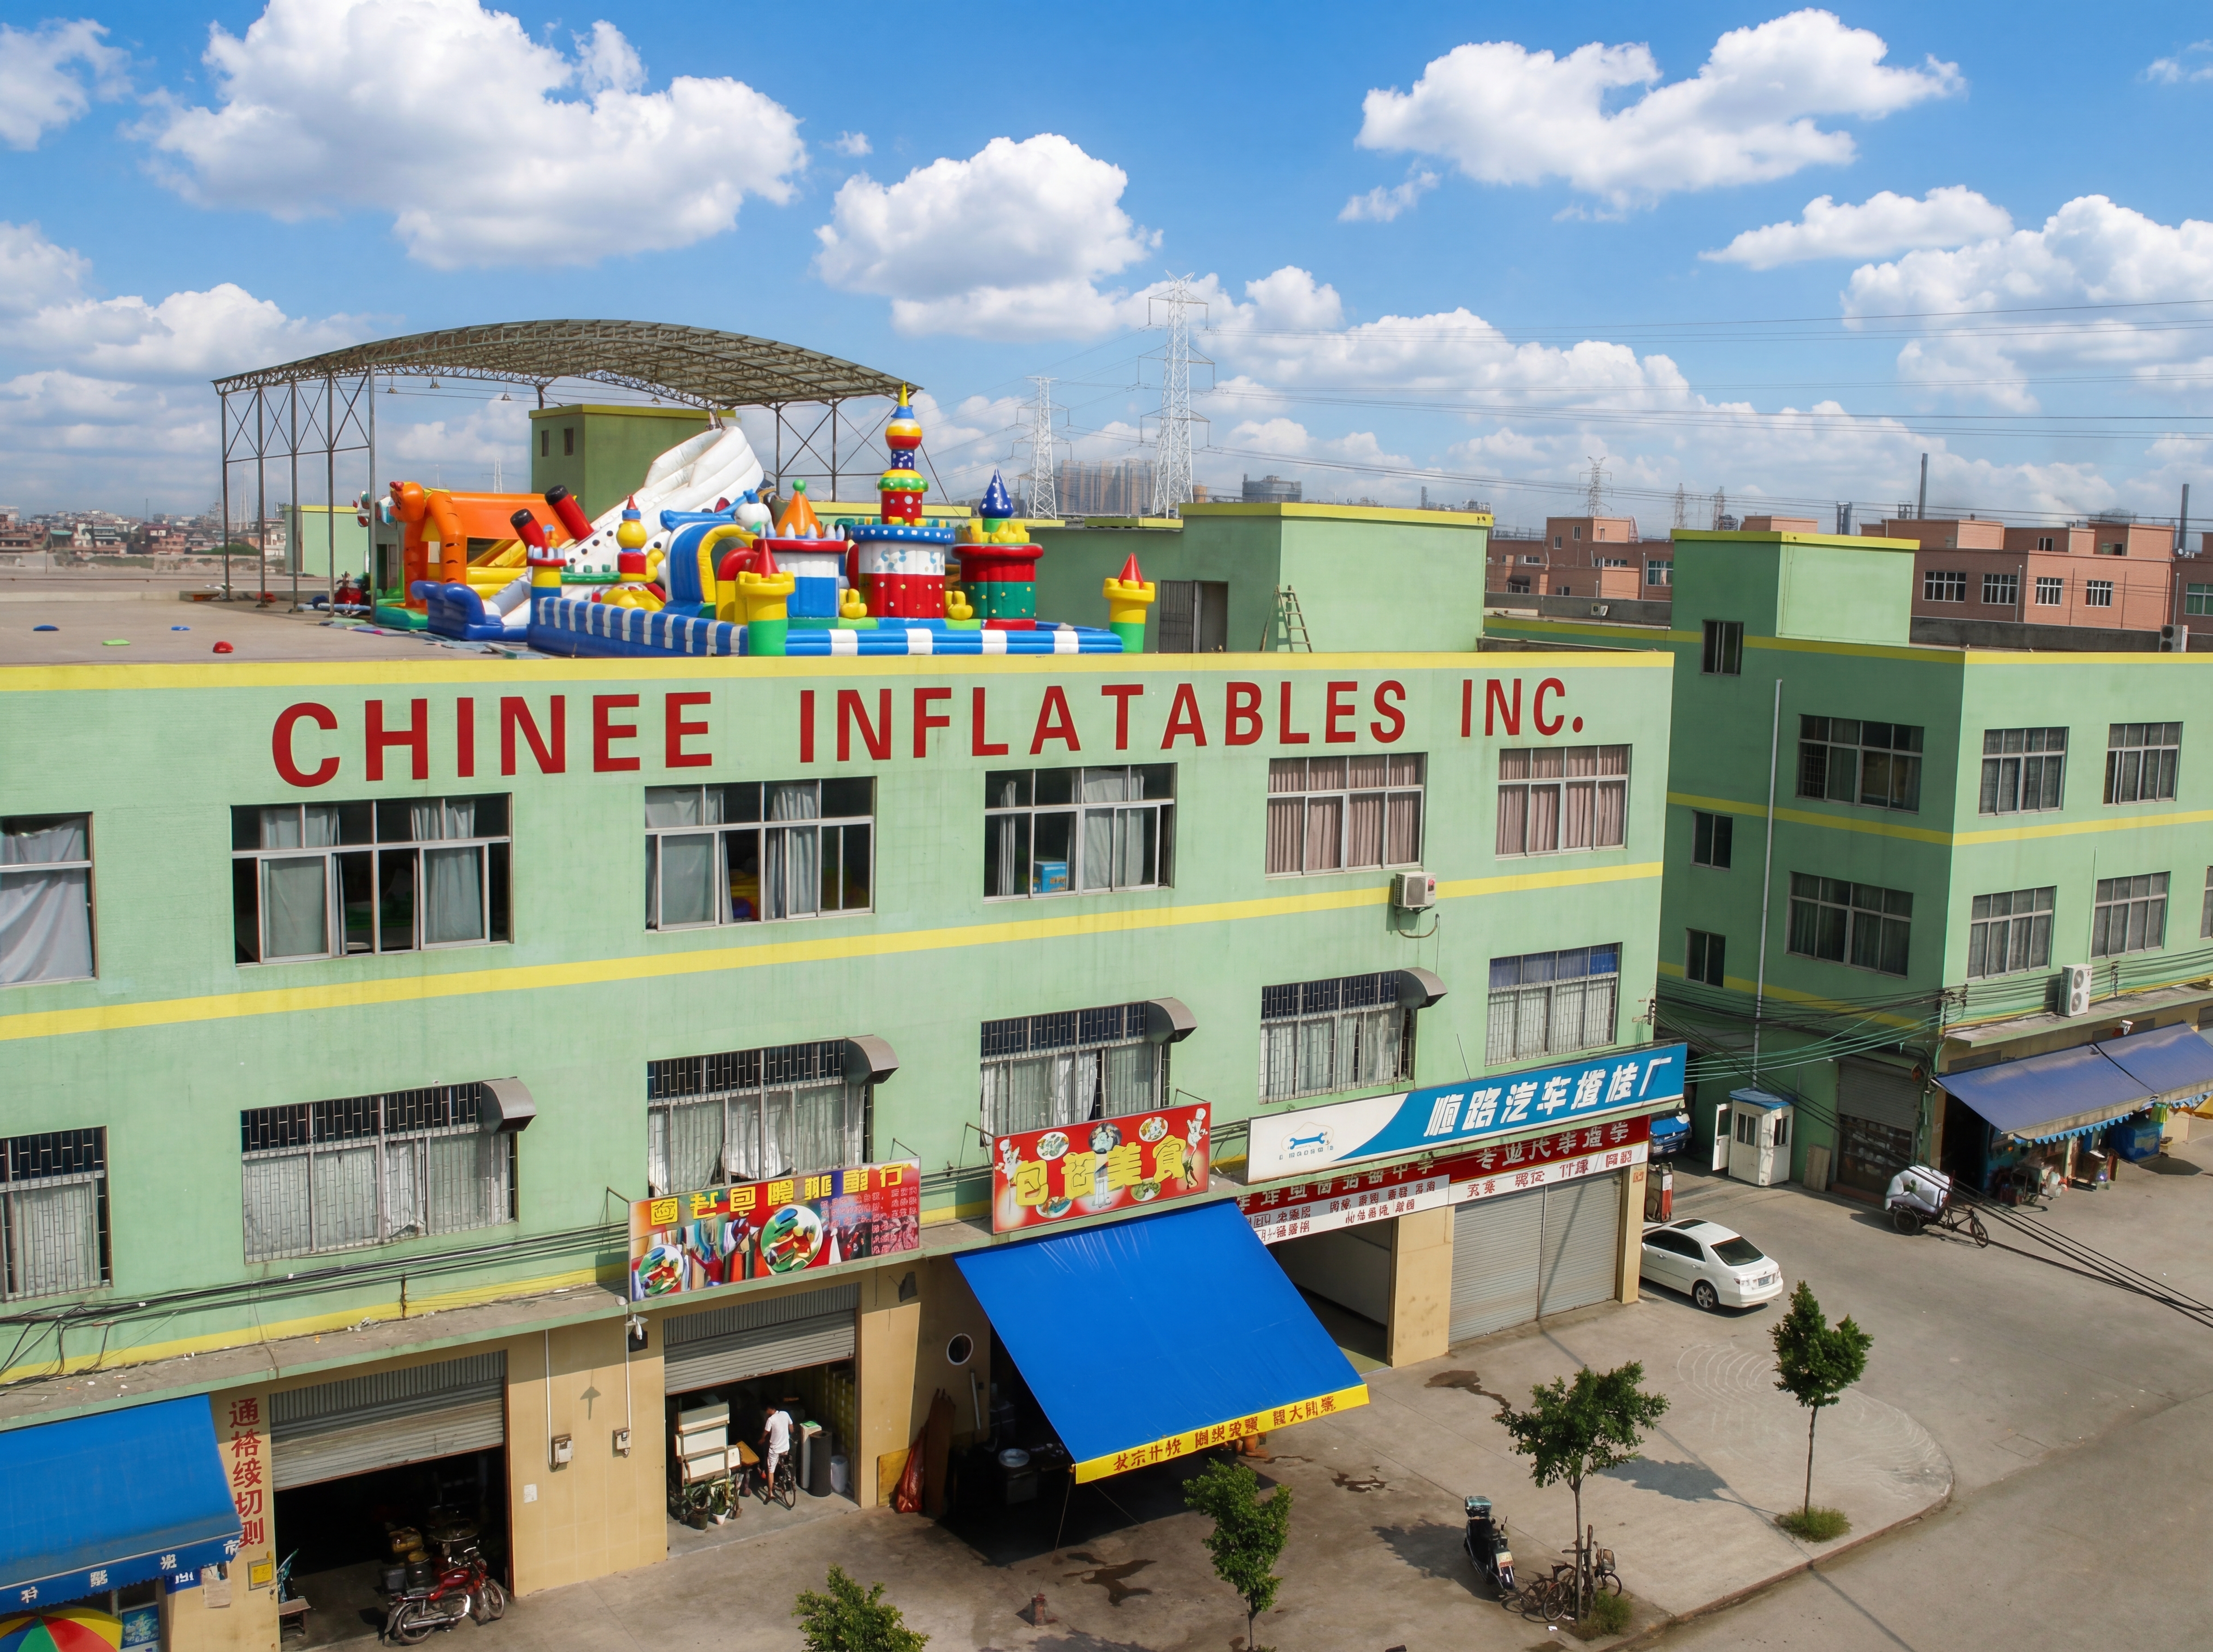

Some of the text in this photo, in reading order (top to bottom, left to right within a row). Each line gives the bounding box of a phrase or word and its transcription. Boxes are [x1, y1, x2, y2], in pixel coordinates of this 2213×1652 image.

[273, 678, 1583, 787] CHINEE INFLATABLES INC.
